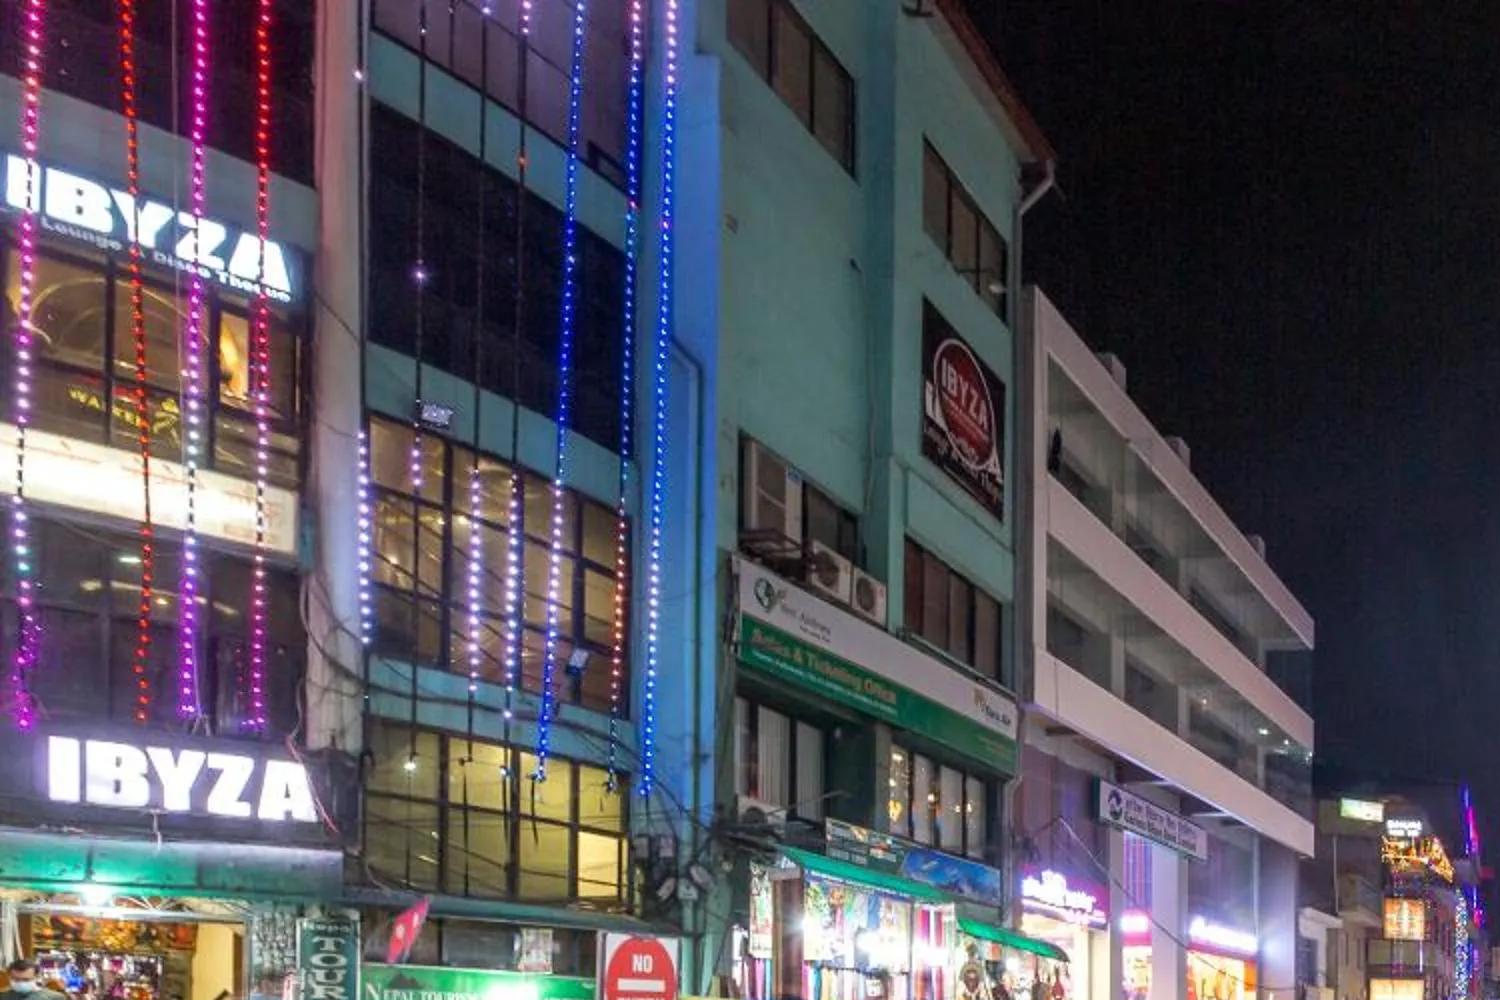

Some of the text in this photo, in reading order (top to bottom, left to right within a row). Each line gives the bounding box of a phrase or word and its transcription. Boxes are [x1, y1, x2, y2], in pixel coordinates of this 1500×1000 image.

[6, 154, 292, 295] IBYZA
[41, 215, 122, 250] Lounge
[941, 357, 990, 433] IBYZA
[47, 735, 318, 823] IBYZA
[632, 954, 653, 974] NO
